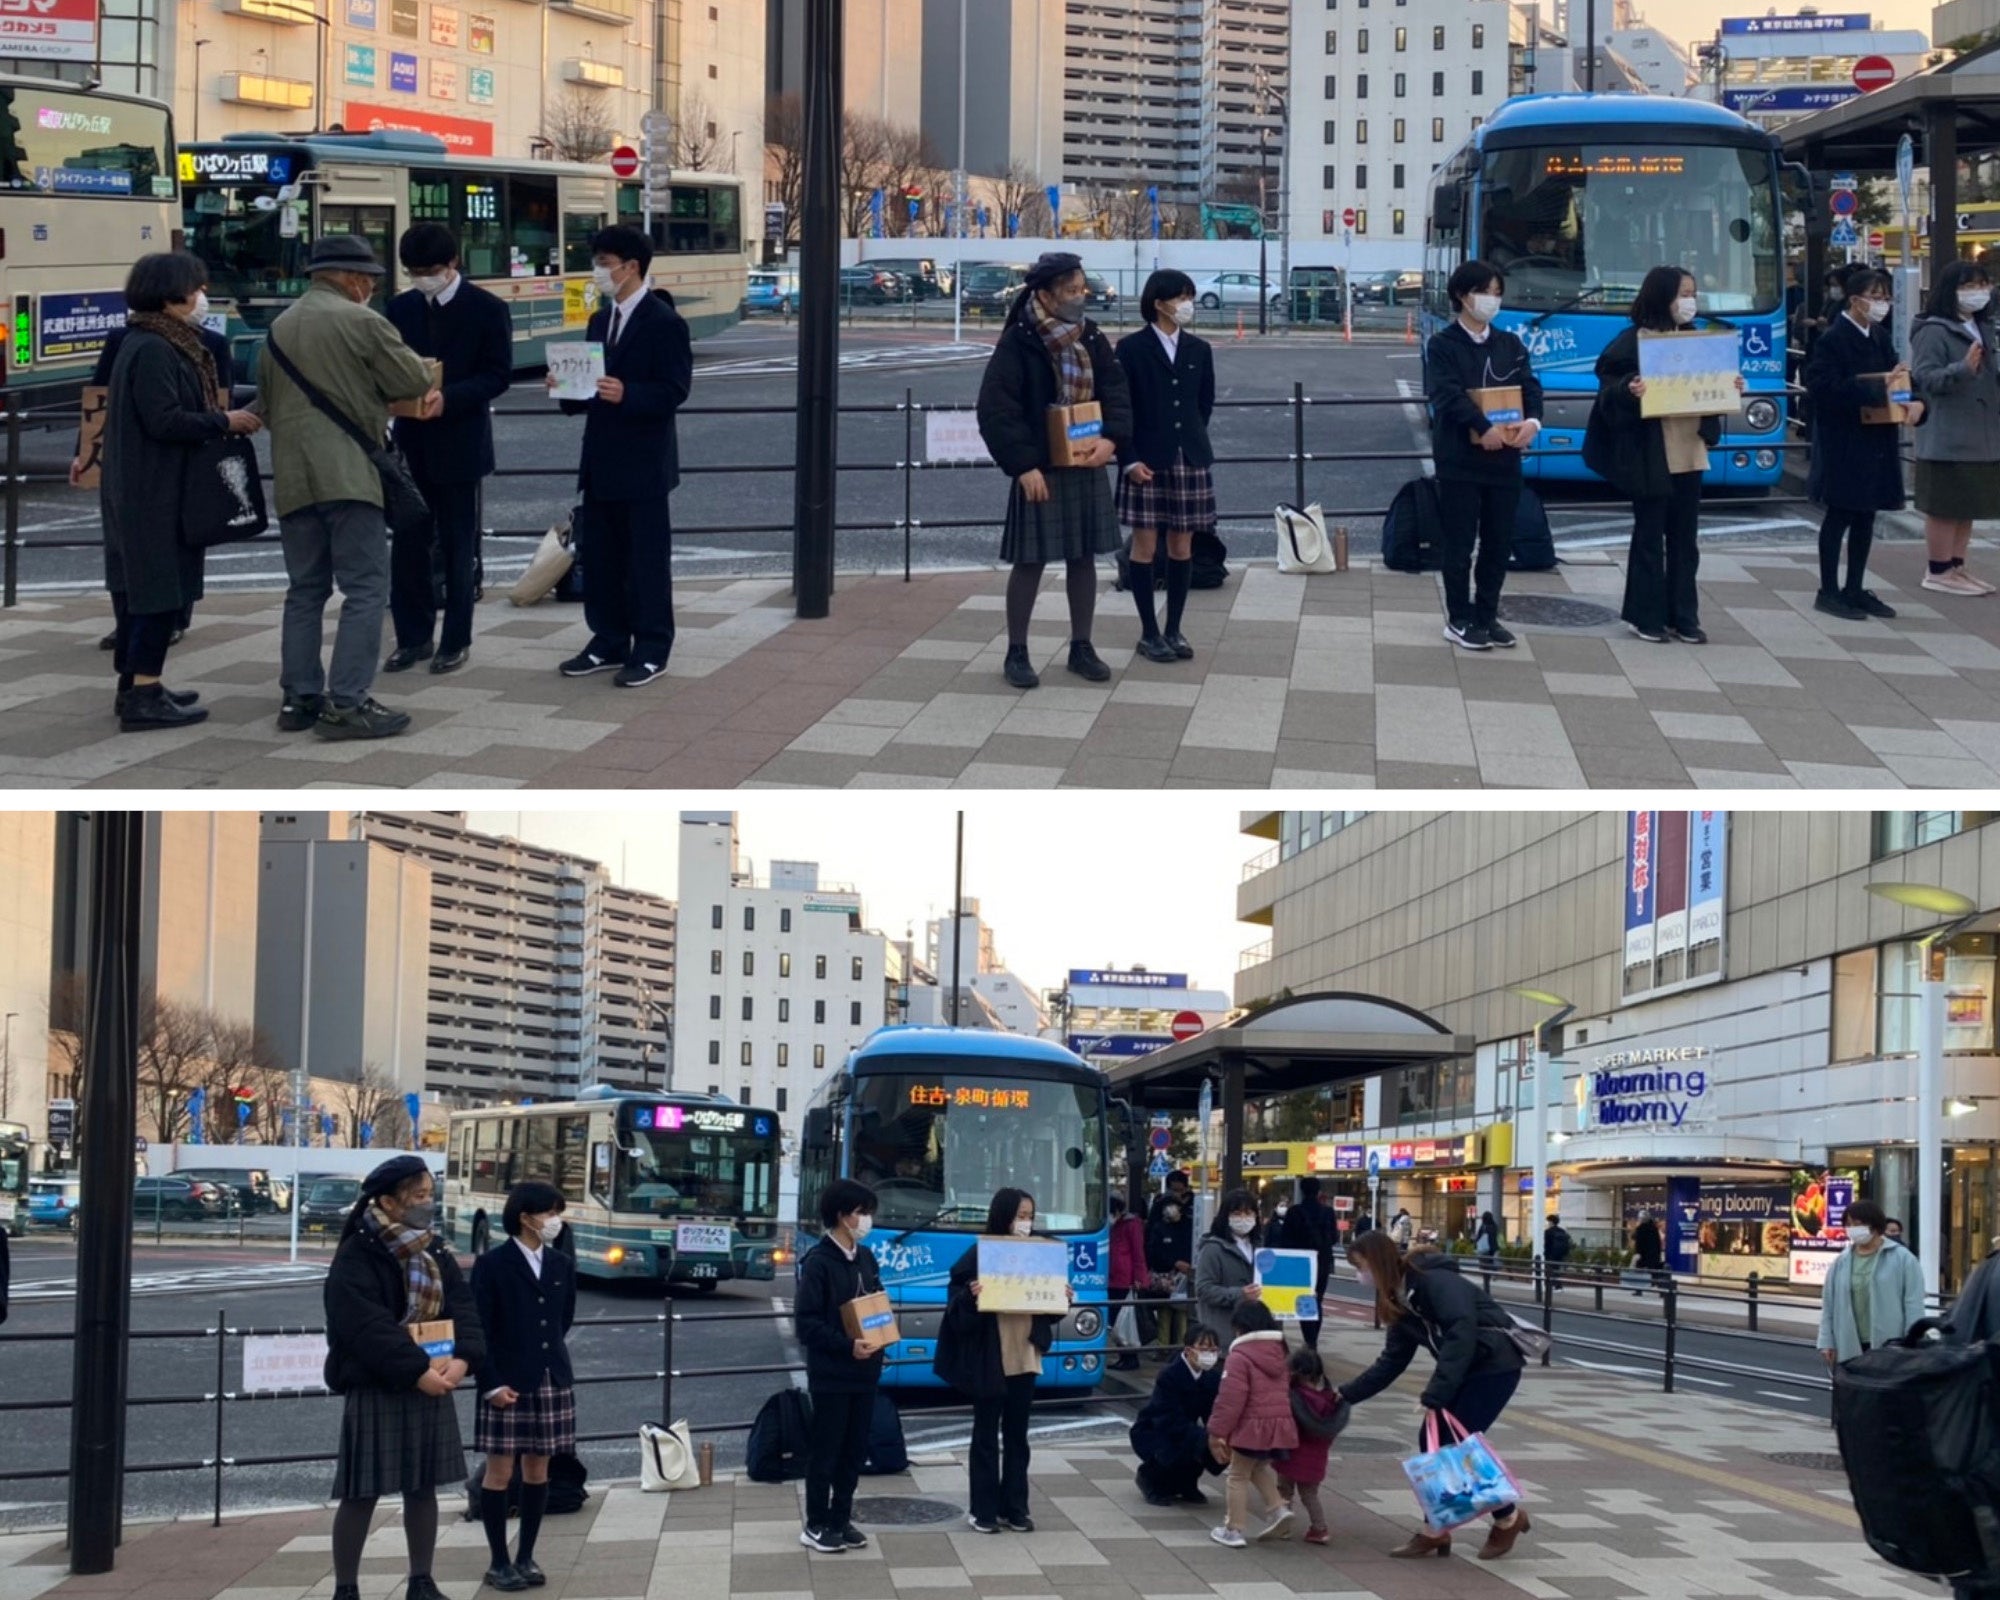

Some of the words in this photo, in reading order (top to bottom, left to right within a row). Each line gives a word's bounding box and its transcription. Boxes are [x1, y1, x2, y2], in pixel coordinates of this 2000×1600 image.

[392, 62, 415, 75] AOKI
[1629, 1046, 1705, 1064] MARKET
[1595, 1066, 1705, 1097] blooming
[1600, 1099, 1688, 1127] bloomy
[1725, 1193, 1773, 1216] bloomy
